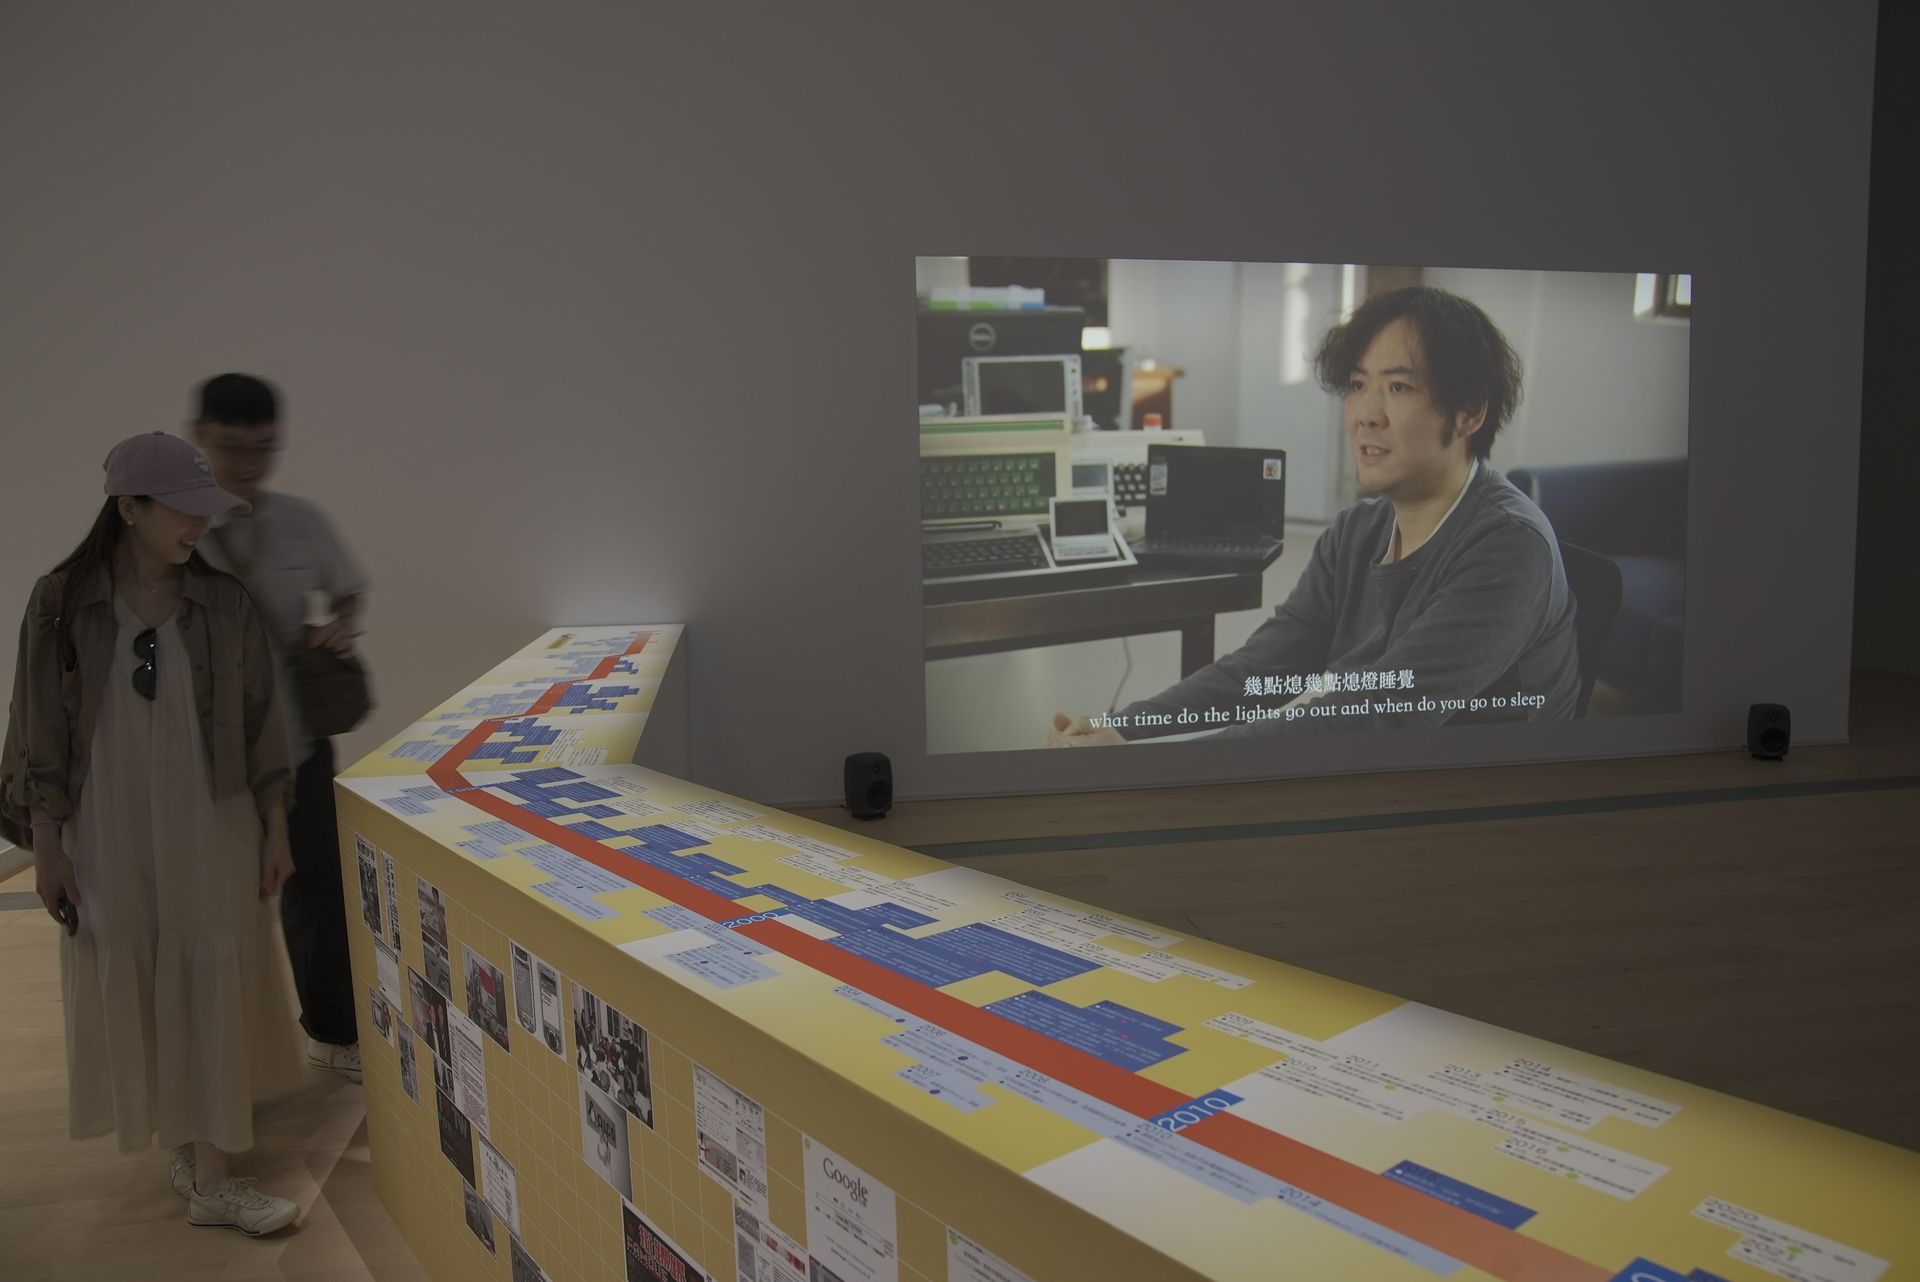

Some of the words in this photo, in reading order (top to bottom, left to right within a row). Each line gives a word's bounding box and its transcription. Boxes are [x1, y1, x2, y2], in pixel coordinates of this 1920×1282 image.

[1243, 668, 1415, 697] 幾點熄幾點熄燈睡覺
[1089, 712, 1129, 729] what
[1134, 710, 1172, 727] time
[1177, 707, 1199, 724] do
[1204, 705, 1230, 723] the
[1235, 703, 1281, 723] lights
[1285, 706, 1305, 722] go
[1309, 703, 1337, 717] out
[1341, 699, 1370, 715] and
[1374, 698, 1413, 714] when
[1417, 696, 1436, 712] do
[1440, 699, 1466, 714] you
[1470, 696, 1488, 712] go
[1492, 695, 1507, 708] to
[1510, 691, 1546, 709] sleep
[722, 912, 778, 929] 2000
[1283, 1057, 1318, 1072] 2010
[1345, 1054, 1381, 1069] 2011
[1444, 1063, 1482, 1079] 2013
[1513, 1056, 1552, 1073] 2014
[1157, 1096, 1230, 1132] 2010
[1504, 1136, 1549, 1156] 2016
[823, 1157, 869, 1202] Google
[1279, 1185, 1322, 1208] 2014
[1705, 1198, 1759, 1222] 2020
